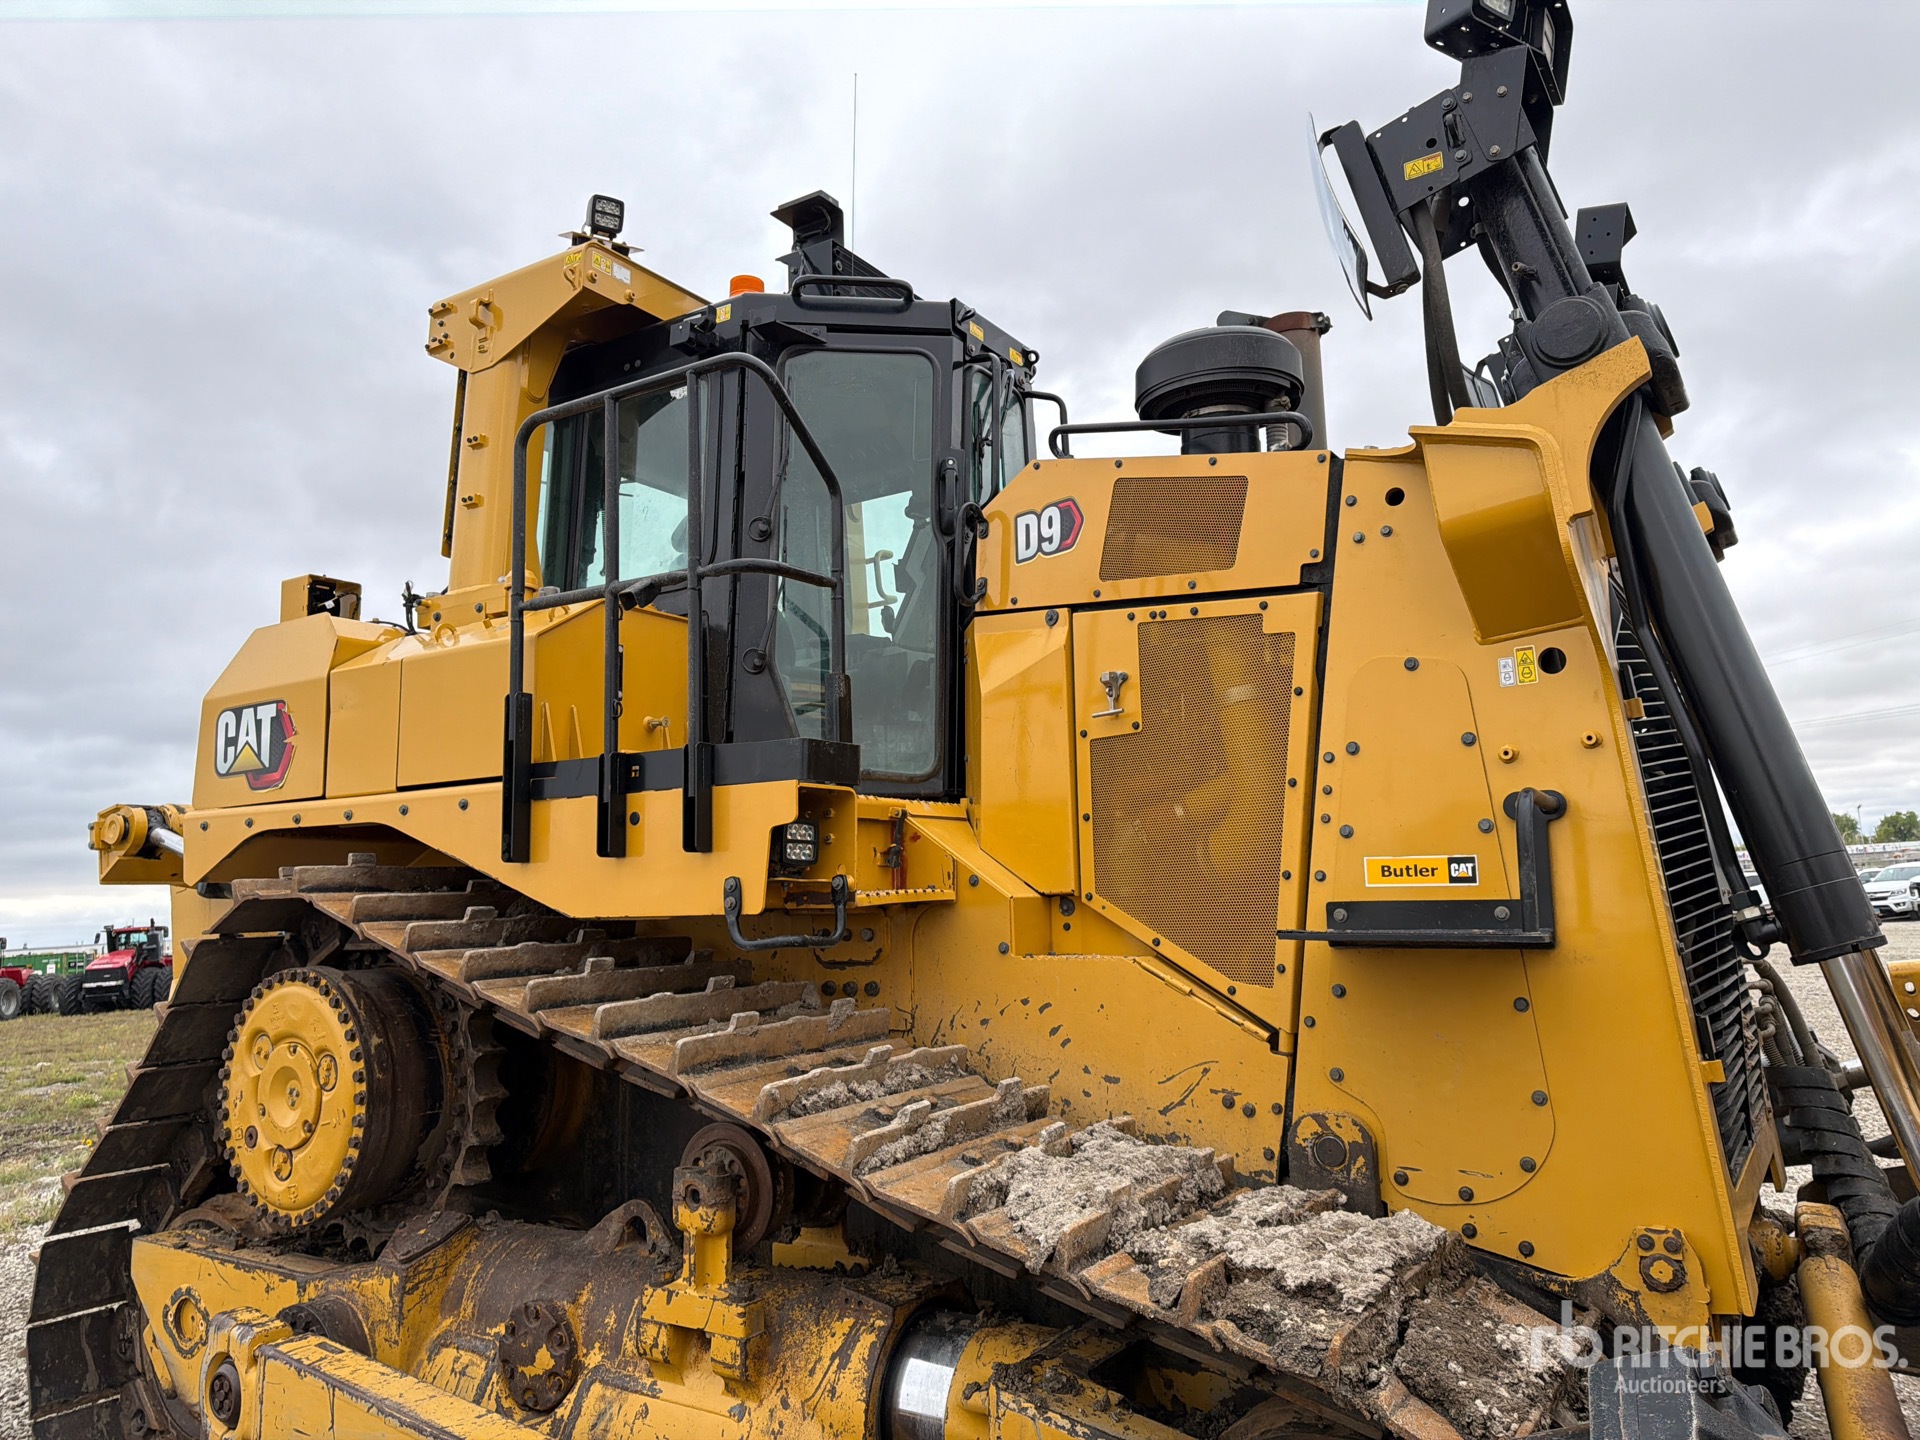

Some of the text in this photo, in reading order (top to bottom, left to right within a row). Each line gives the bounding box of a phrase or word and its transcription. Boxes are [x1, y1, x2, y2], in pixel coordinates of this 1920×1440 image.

[1016, 506, 1061, 561] D9
[216, 702, 277, 775] CAT
[1380, 863, 1474, 878] Butler CAT
